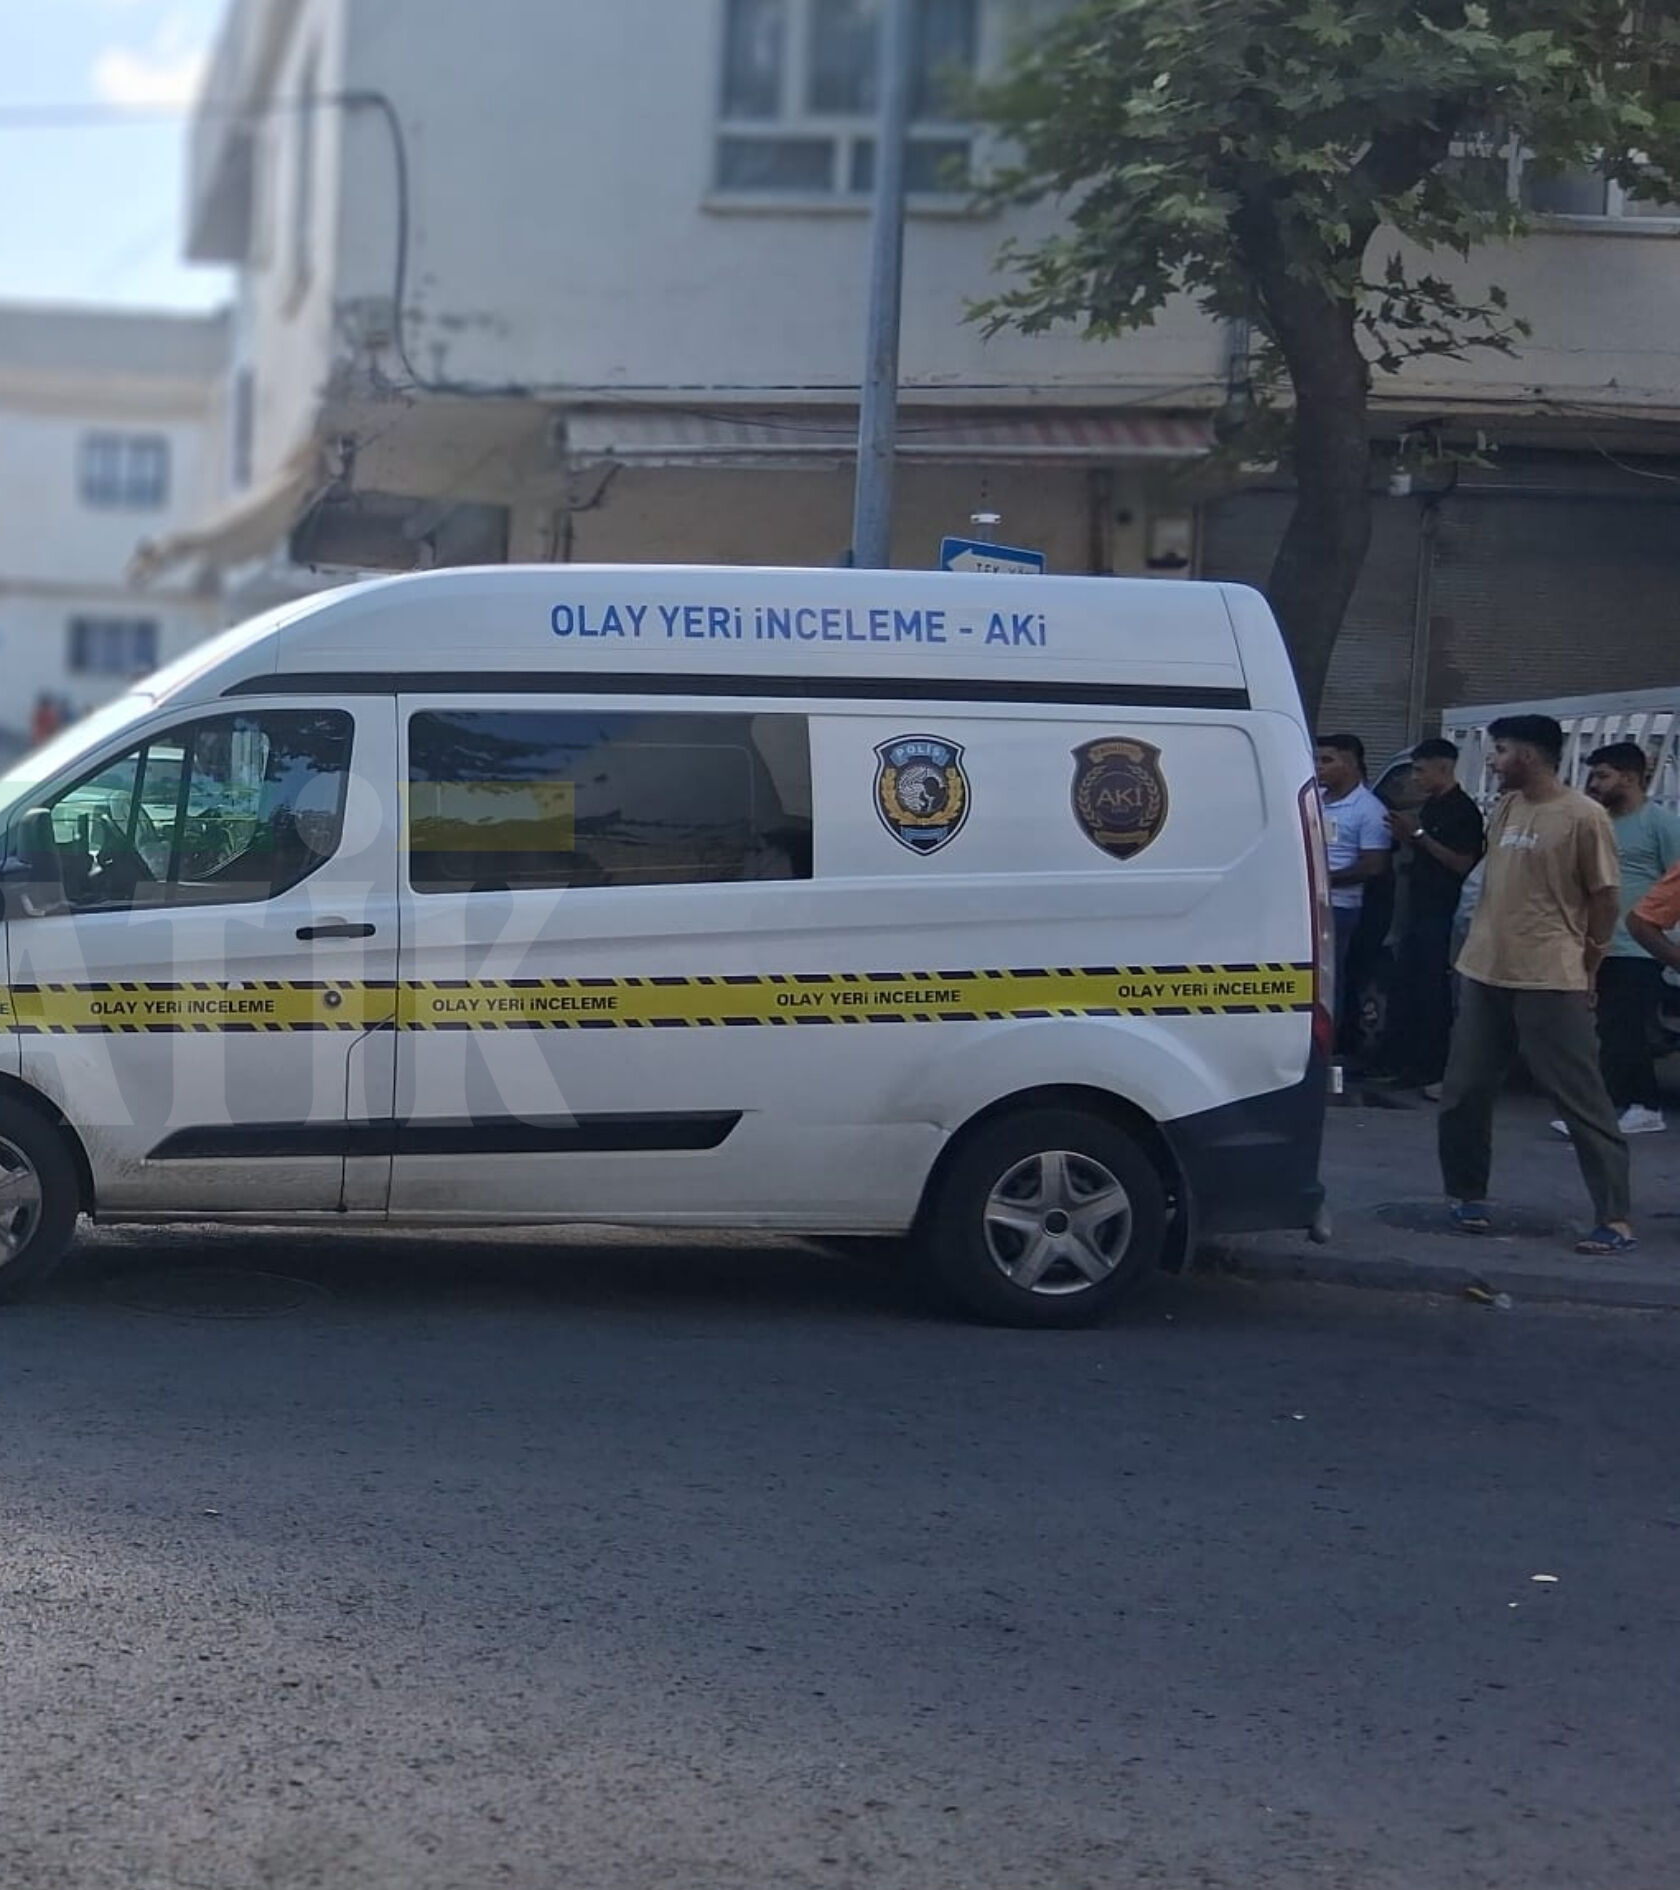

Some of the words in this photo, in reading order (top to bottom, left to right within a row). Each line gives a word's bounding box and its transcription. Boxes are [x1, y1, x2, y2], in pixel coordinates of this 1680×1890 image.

[550, 604, 648, 637] OLAY
[1117, 984, 1165, 998] OLAY
[432, 998, 480, 1011] OLAY
[776, 993, 824, 1006] OLAY
[90, 1001, 137, 1014] OLAY
